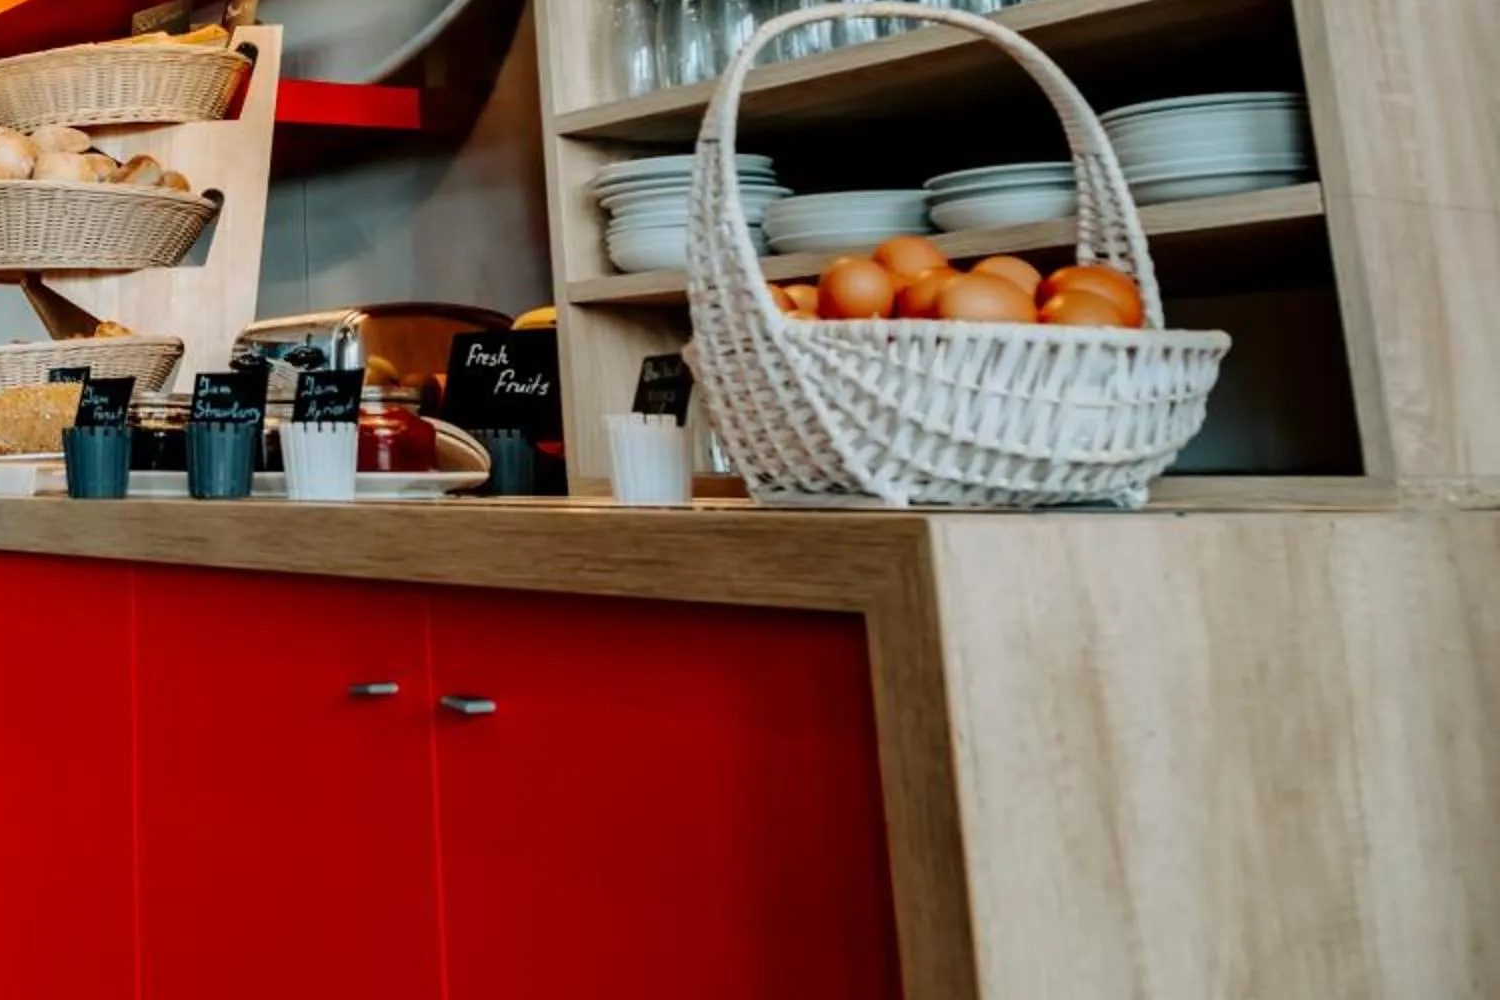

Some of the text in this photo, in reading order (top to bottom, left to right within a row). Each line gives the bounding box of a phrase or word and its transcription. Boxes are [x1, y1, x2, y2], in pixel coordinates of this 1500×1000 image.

[465, 343, 509, 367] Fresh
[198, 376, 232, 397] Jam
[301, 376, 339, 397] Jam
[493, 369, 550, 396] Fruits
